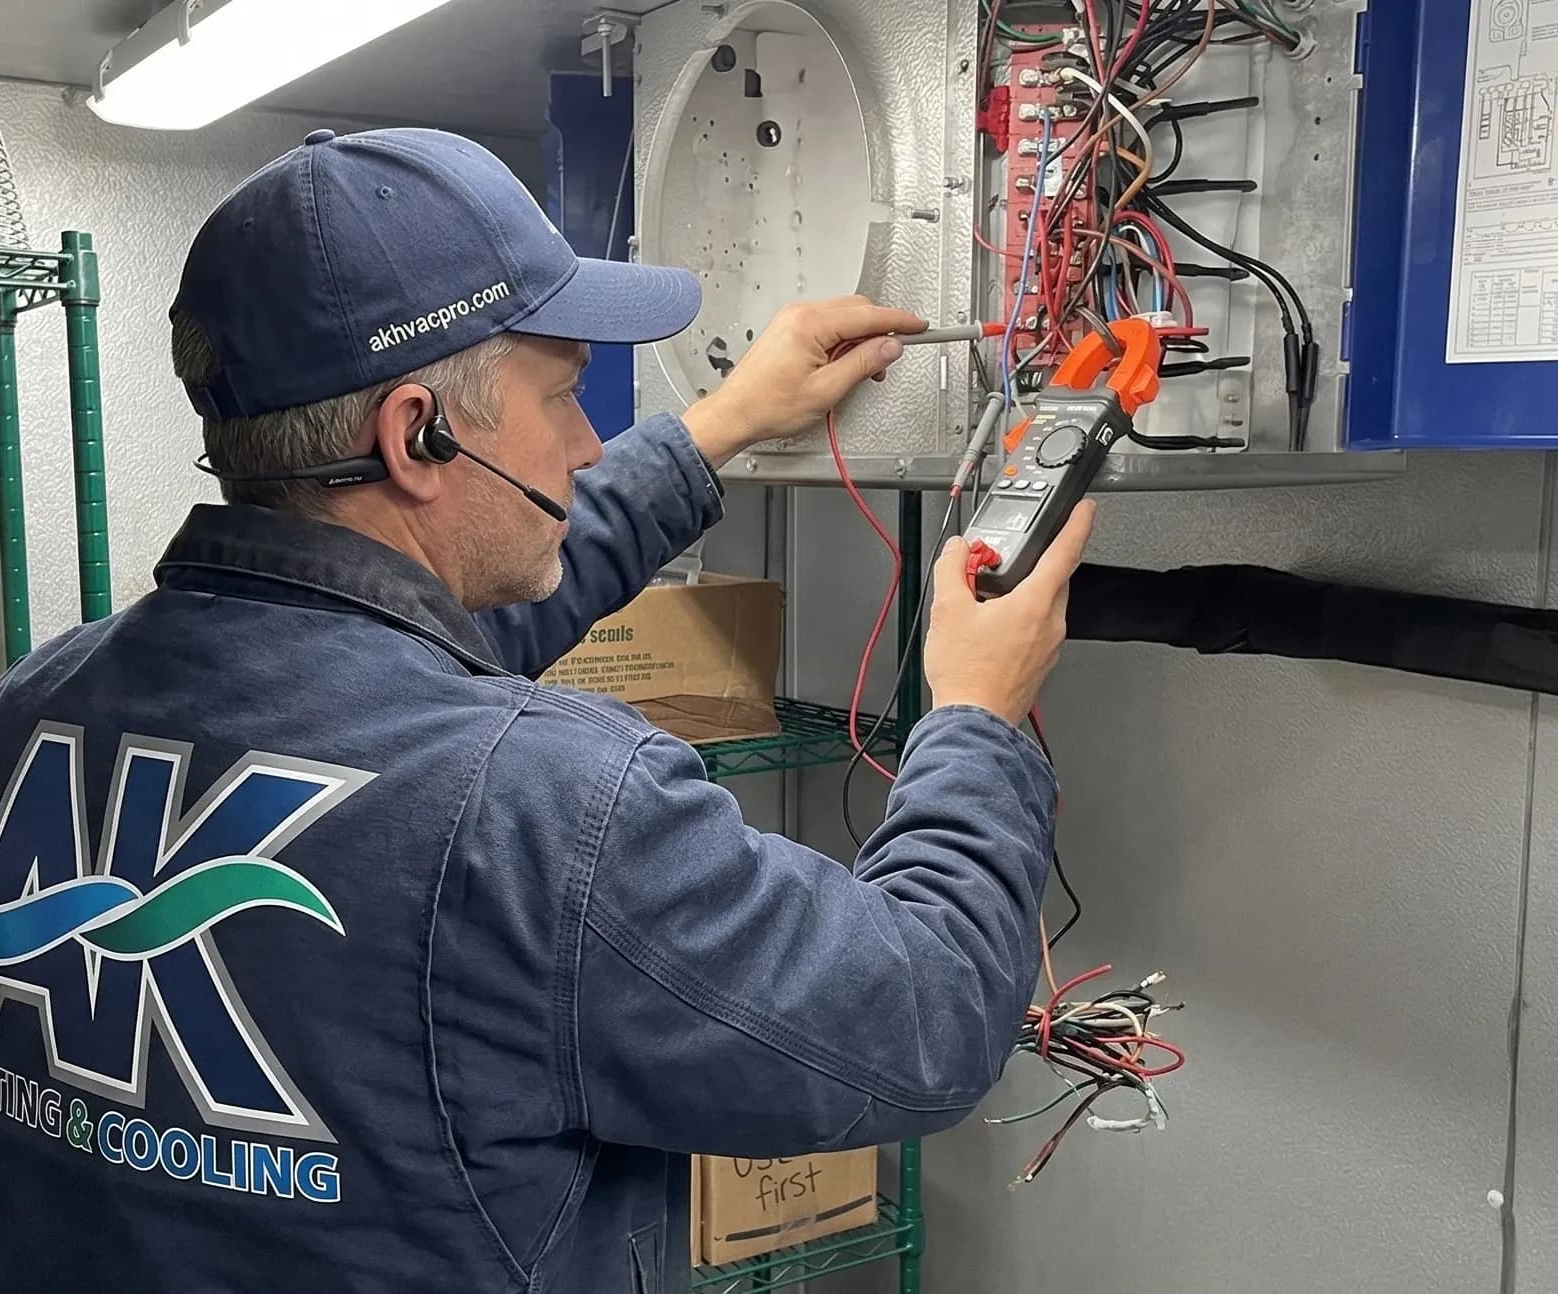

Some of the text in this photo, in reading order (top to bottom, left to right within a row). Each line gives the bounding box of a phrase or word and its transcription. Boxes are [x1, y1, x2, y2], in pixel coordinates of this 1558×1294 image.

[368, 281, 510, 352] akhvacpro.com
[66, 1097, 94, 1154] &
[97, 1110, 341, 1203] COOLING
[755, 1161, 822, 1211] first
